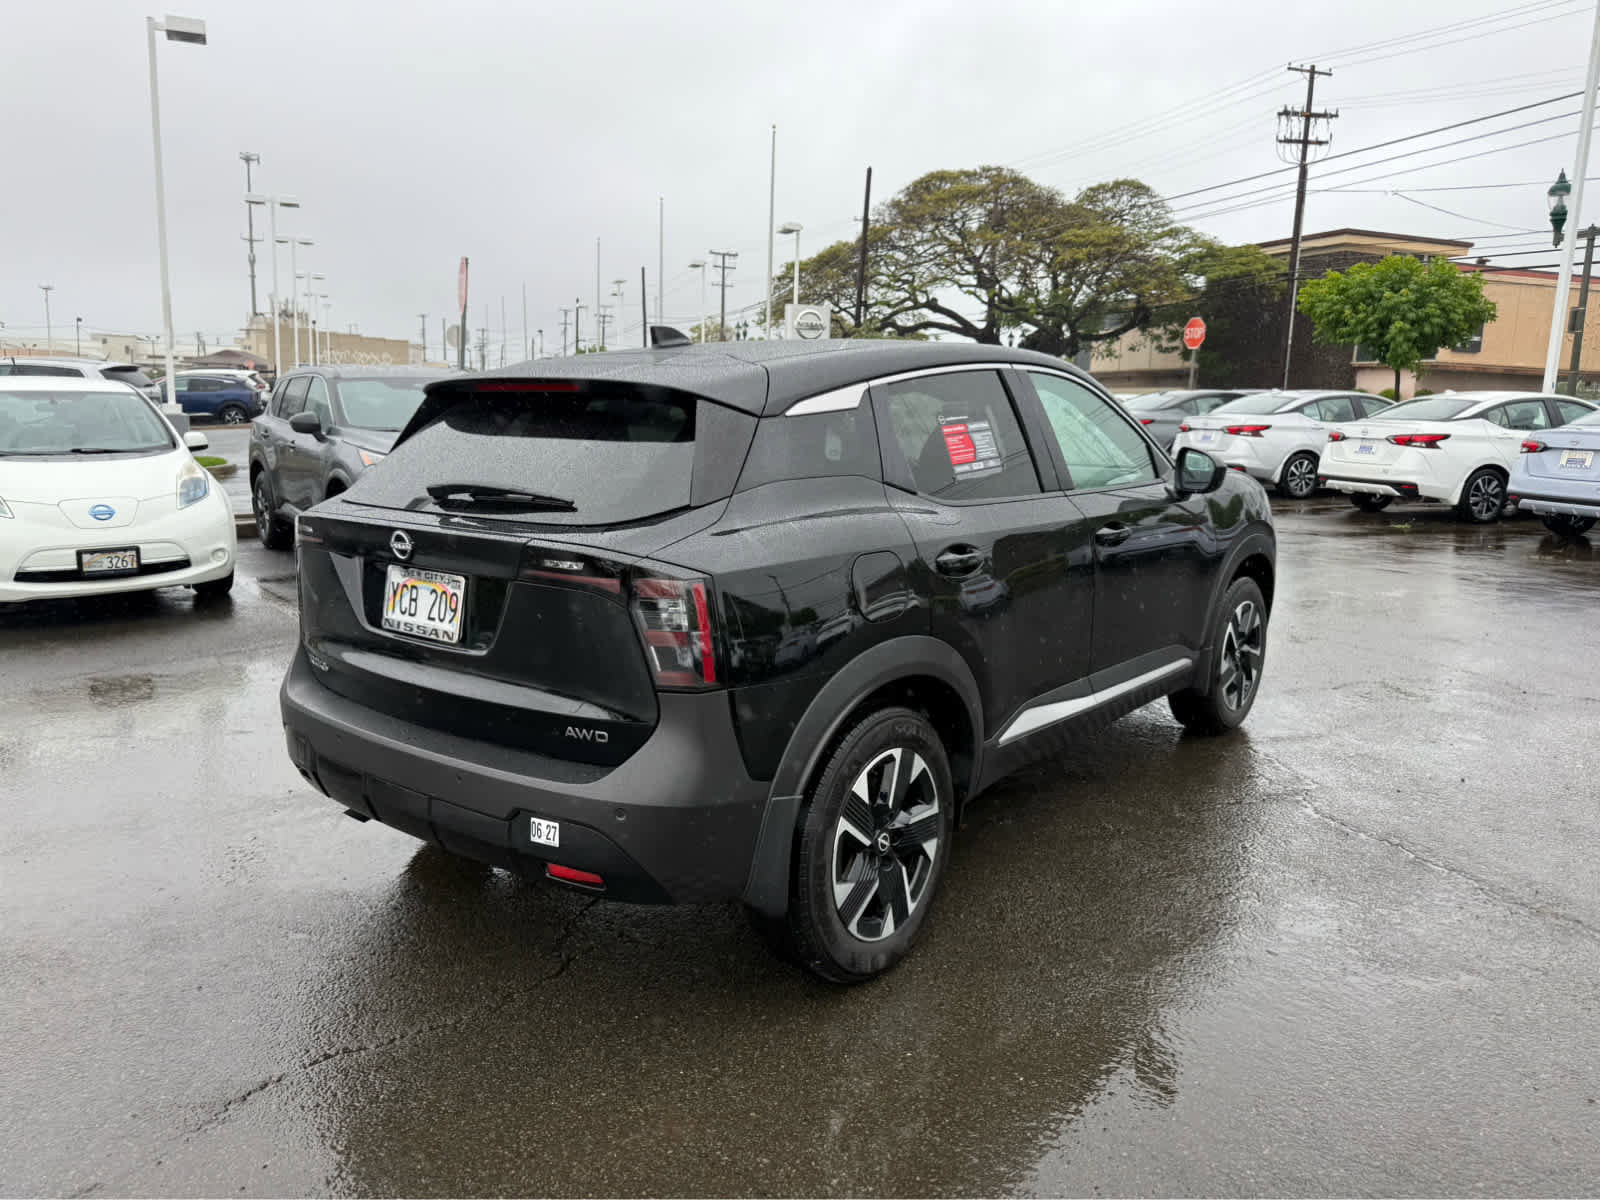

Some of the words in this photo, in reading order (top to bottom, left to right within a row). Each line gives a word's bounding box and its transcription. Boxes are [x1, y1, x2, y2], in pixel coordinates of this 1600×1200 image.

[1185, 327, 1205, 338] STOP
[106, 554, 135, 568] 3267
[424, 571, 445, 581] CITY
[391, 581, 419, 617] YCB
[427, 588, 459, 624] 209
[383, 617, 455, 641] NISSAN
[564, 726, 608, 742] AWD
